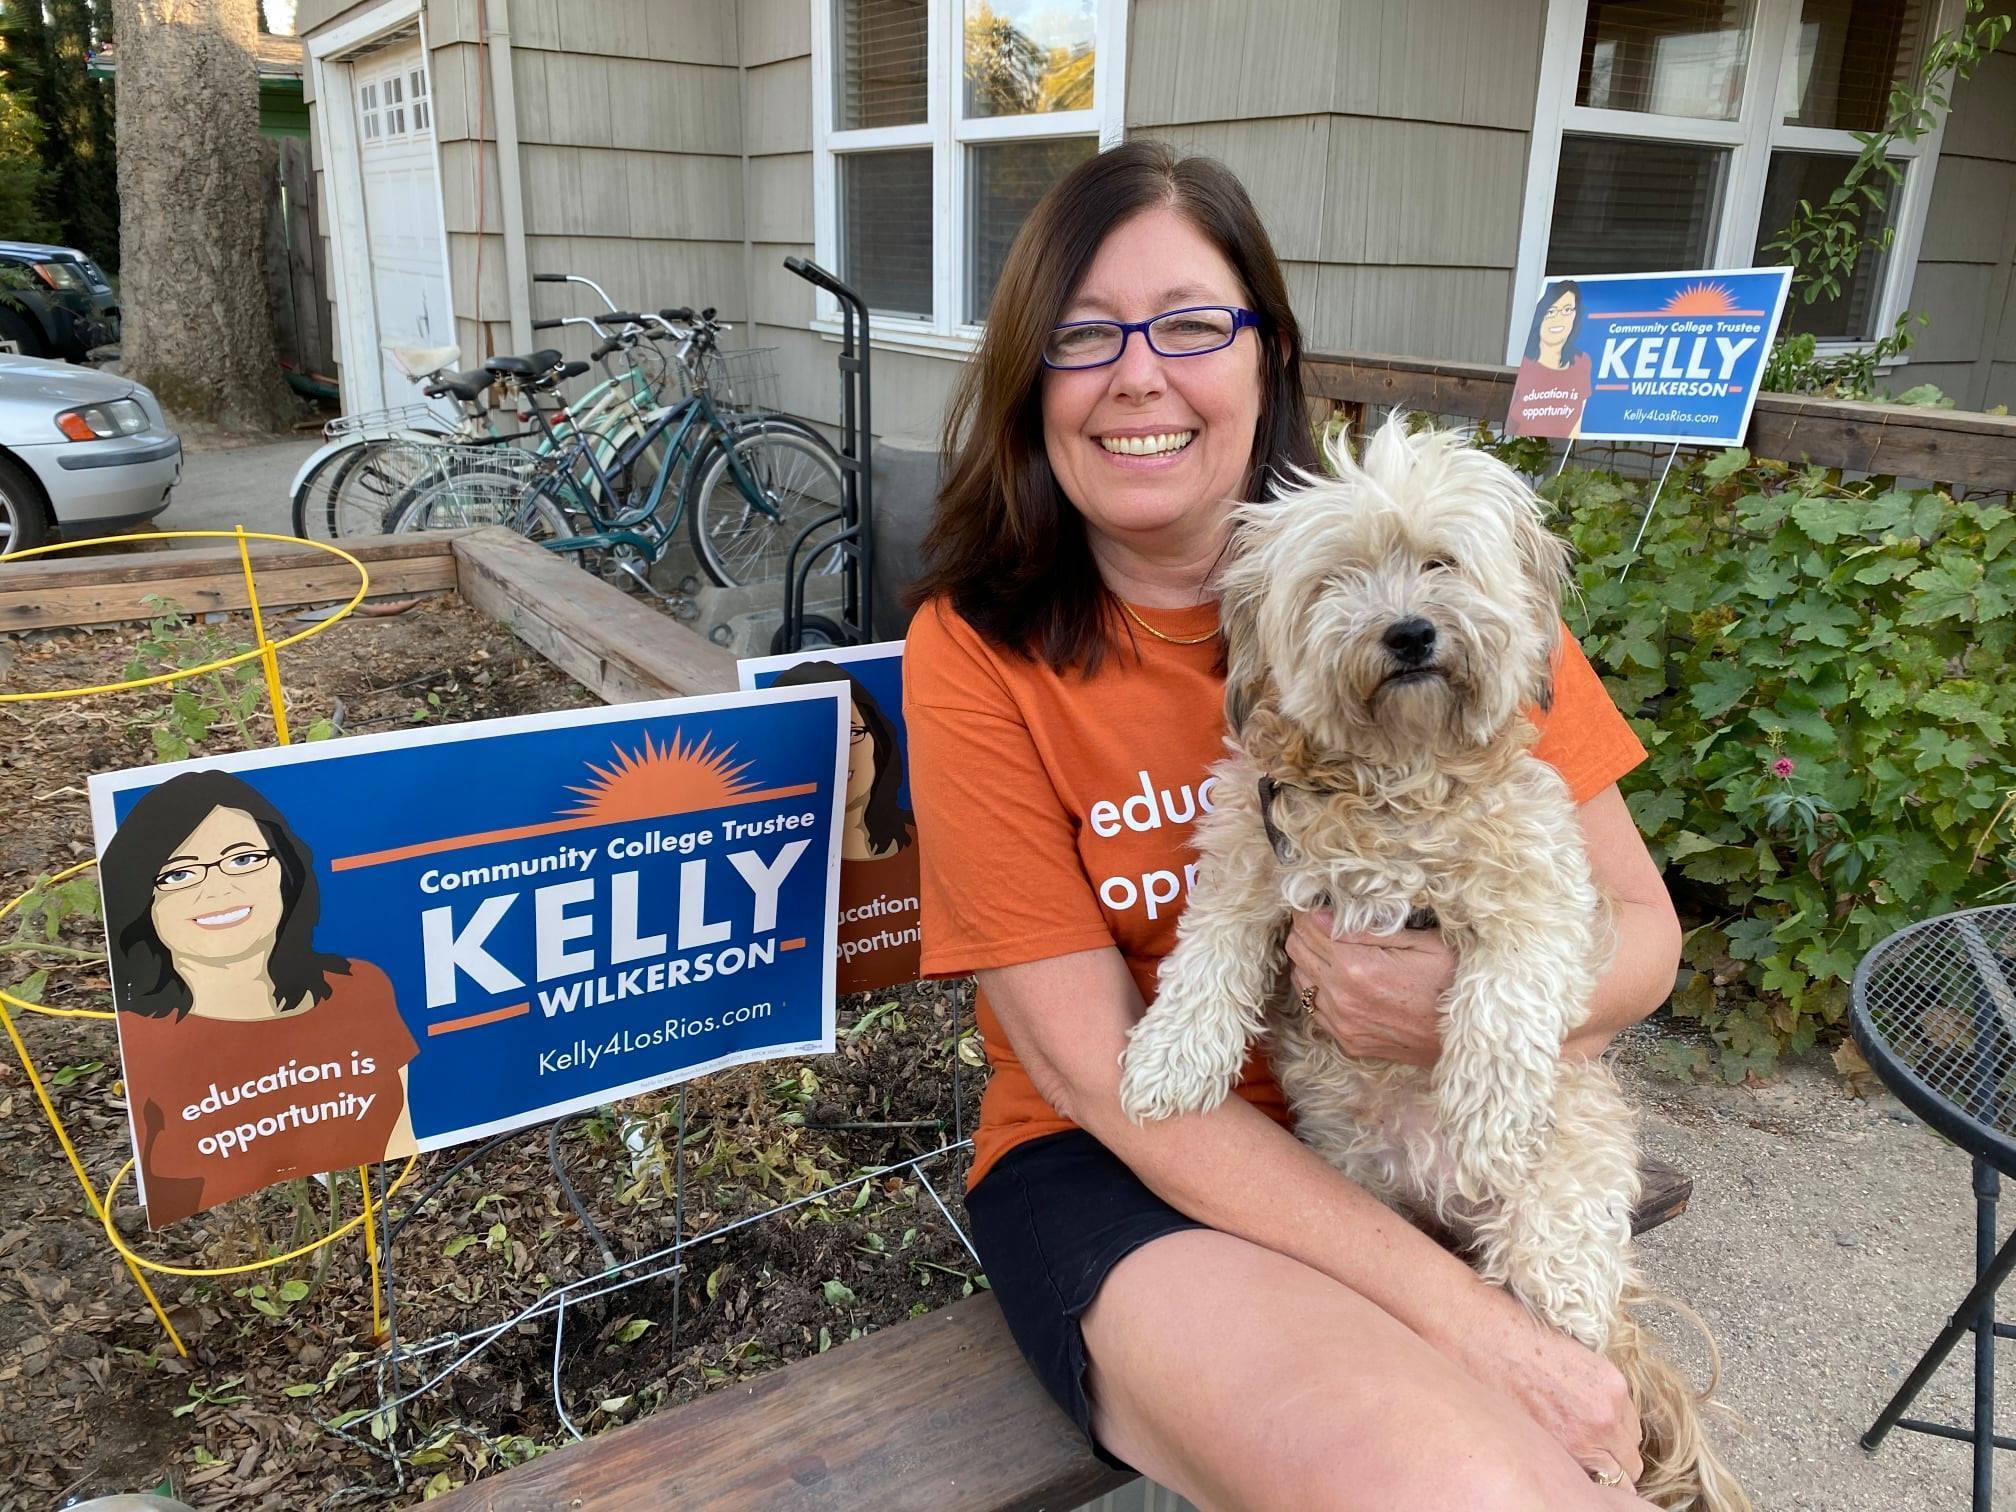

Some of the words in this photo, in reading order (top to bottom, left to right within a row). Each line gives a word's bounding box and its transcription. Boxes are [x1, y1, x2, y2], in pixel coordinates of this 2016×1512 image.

[1609, 322, 1668, 335] Community
[1671, 321, 1713, 335] College
[1716, 322, 1761, 333] Trustee
[1597, 337, 1758, 380] KELLY
[1523, 387, 1569, 402] education
[1570, 388, 1579, 400] is
[1523, 405, 1575, 420] opportunity
[1623, 408, 1719, 424] Kelly4LosRios.com
[1631, 382, 1729, 397] WILKERSON
[419, 846, 597, 894] Community
[607, 826, 713, 860] College
[722, 812, 815, 842] Trustee
[421, 839, 812, 1009] KELLY
[537, 937, 775, 1018] WILKERSON
[538, 1000, 772, 1077] Kelly4LosRios.com
[182, 1059, 342, 1121] education
[351, 1050, 376, 1076] is
[198, 1092, 377, 1159] opportunity
